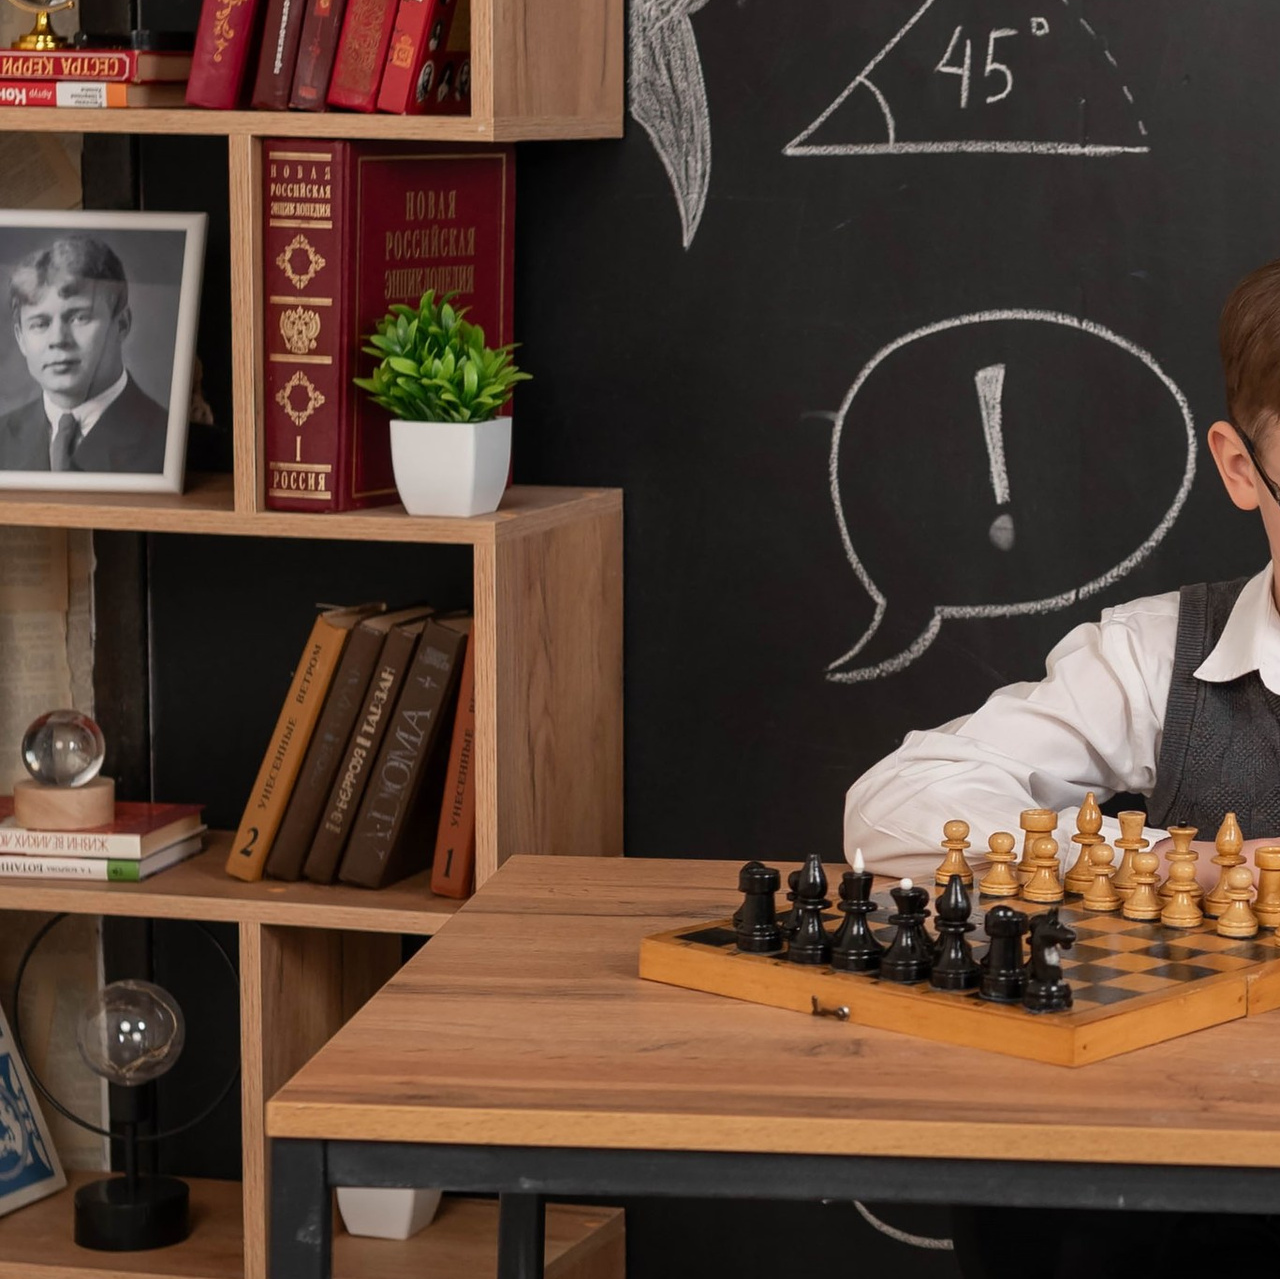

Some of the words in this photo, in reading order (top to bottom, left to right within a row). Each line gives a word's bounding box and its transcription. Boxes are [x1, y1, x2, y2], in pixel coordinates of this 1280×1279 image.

[2, 56, 54, 76] КЕРРИ
[61, 57, 119, 76] СЕСТРА
[270, 163, 331, 180] НОВАЯ
[270, 182, 331, 199] РОССИЙСКАЯ
[270, 201, 331, 219] ЭНЦИКЛОПЕДИЯ
[405, 189, 457, 221] НОВАЯ
[385, 224, 476, 261] РОССИЙСКАЯ
[384, 265, 475, 301] ЭНЦИКЛОПЕДИЯ
[272, 471, 326, 492] РОССИЯ
[239, 826, 260, 857] 2
[256, 717, 299, 811] УНЕСЕННЫЕ
[295, 643, 322, 705] ВЕТРОМ
[444, 848, 455, 878] 1
[451, 727, 474, 828] УНЕСЕННЫЕ
[15, 835, 64, 851] ВЕЛИКИХ
[67, 837, 110, 853] ЖИЗНИ
